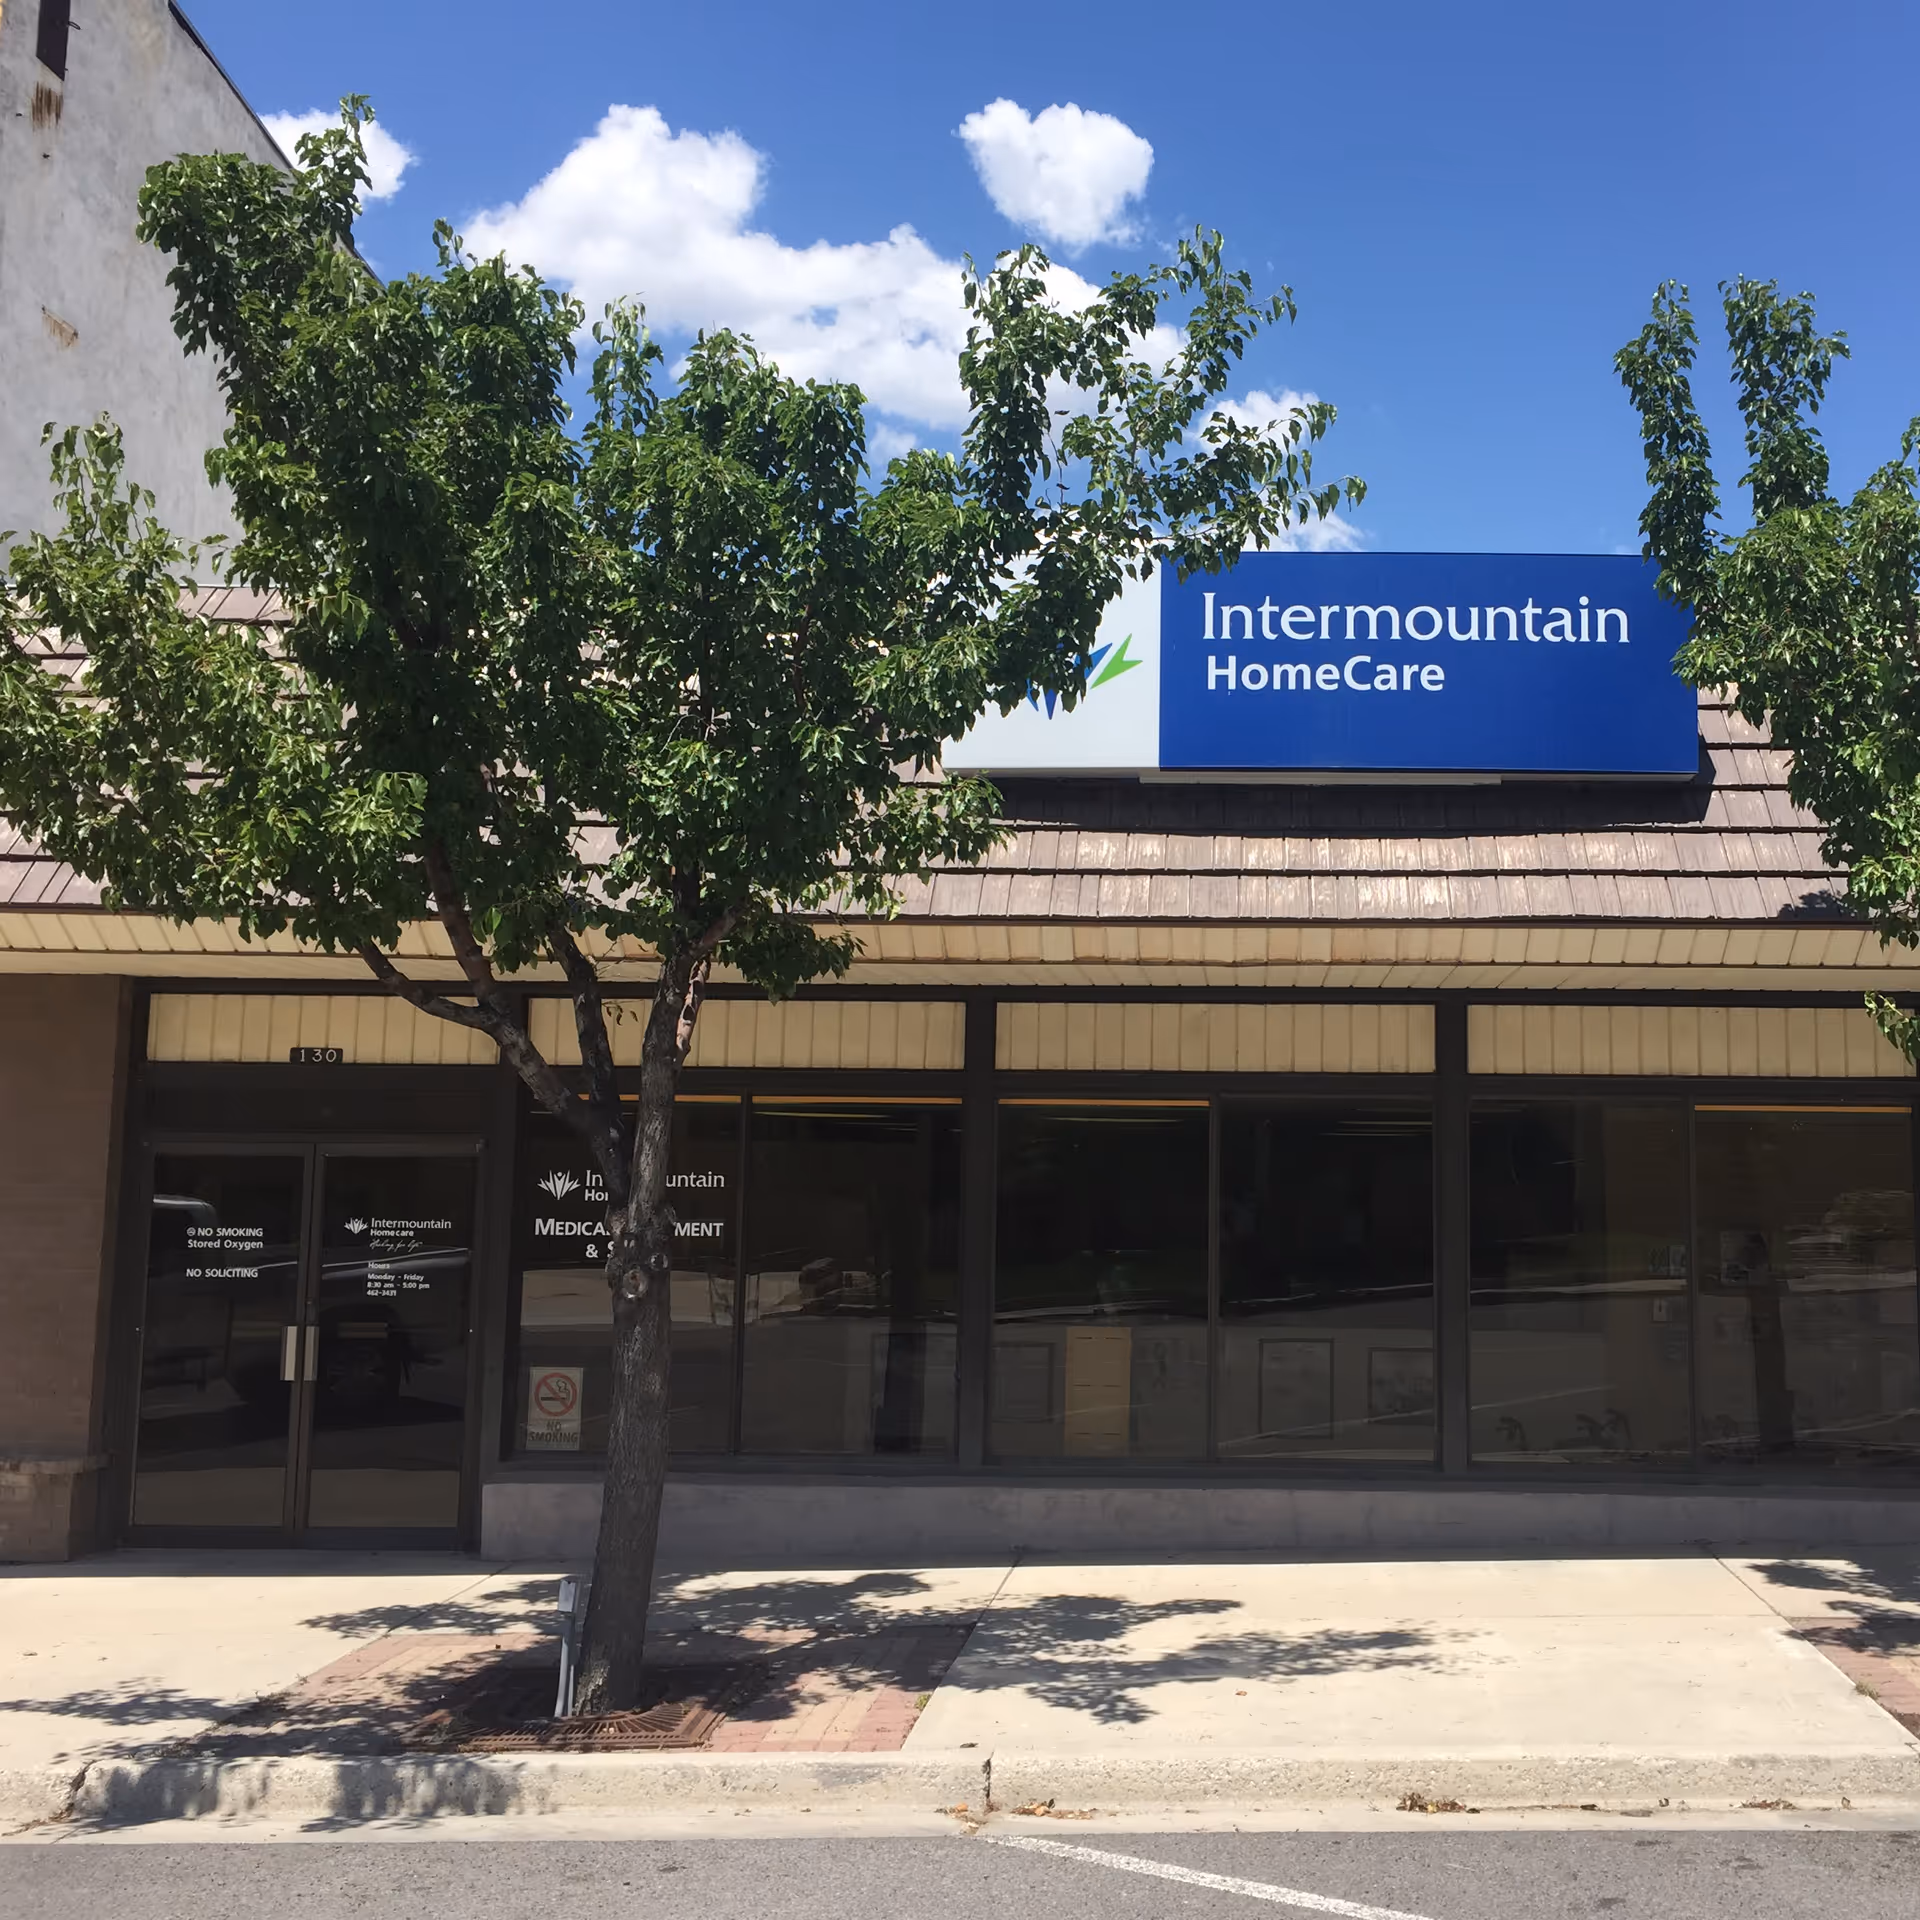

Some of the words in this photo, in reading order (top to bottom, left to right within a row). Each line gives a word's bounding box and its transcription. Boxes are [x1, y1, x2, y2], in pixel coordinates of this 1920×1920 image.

[1203, 592, 1630, 643] Intermountain
[1207, 655, 1445, 691] HomeCare
[300, 1049, 336, 1062] 130
[586, 1169, 725, 1188] Inuntain
[371, 1218, 451, 1229] Intermountain
[534, 1218, 611, 1236] MEDICA
[197, 1227, 213, 1236] NO
[216, 1227, 263, 1236] SMOKING
[187, 1239, 221, 1248] Stored
[224, 1239, 263, 1251] Oxygen
[585, 1244, 599, 1259] &
[186, 1268, 202, 1278] NO
[205, 1268, 258, 1278] SOLICITING
[367, 1273, 395, 1281] Monday
[403, 1274, 424, 1282] Friday
[546, 1421, 562, 1432] NO
[528, 1431, 579, 1443] SMOKING
